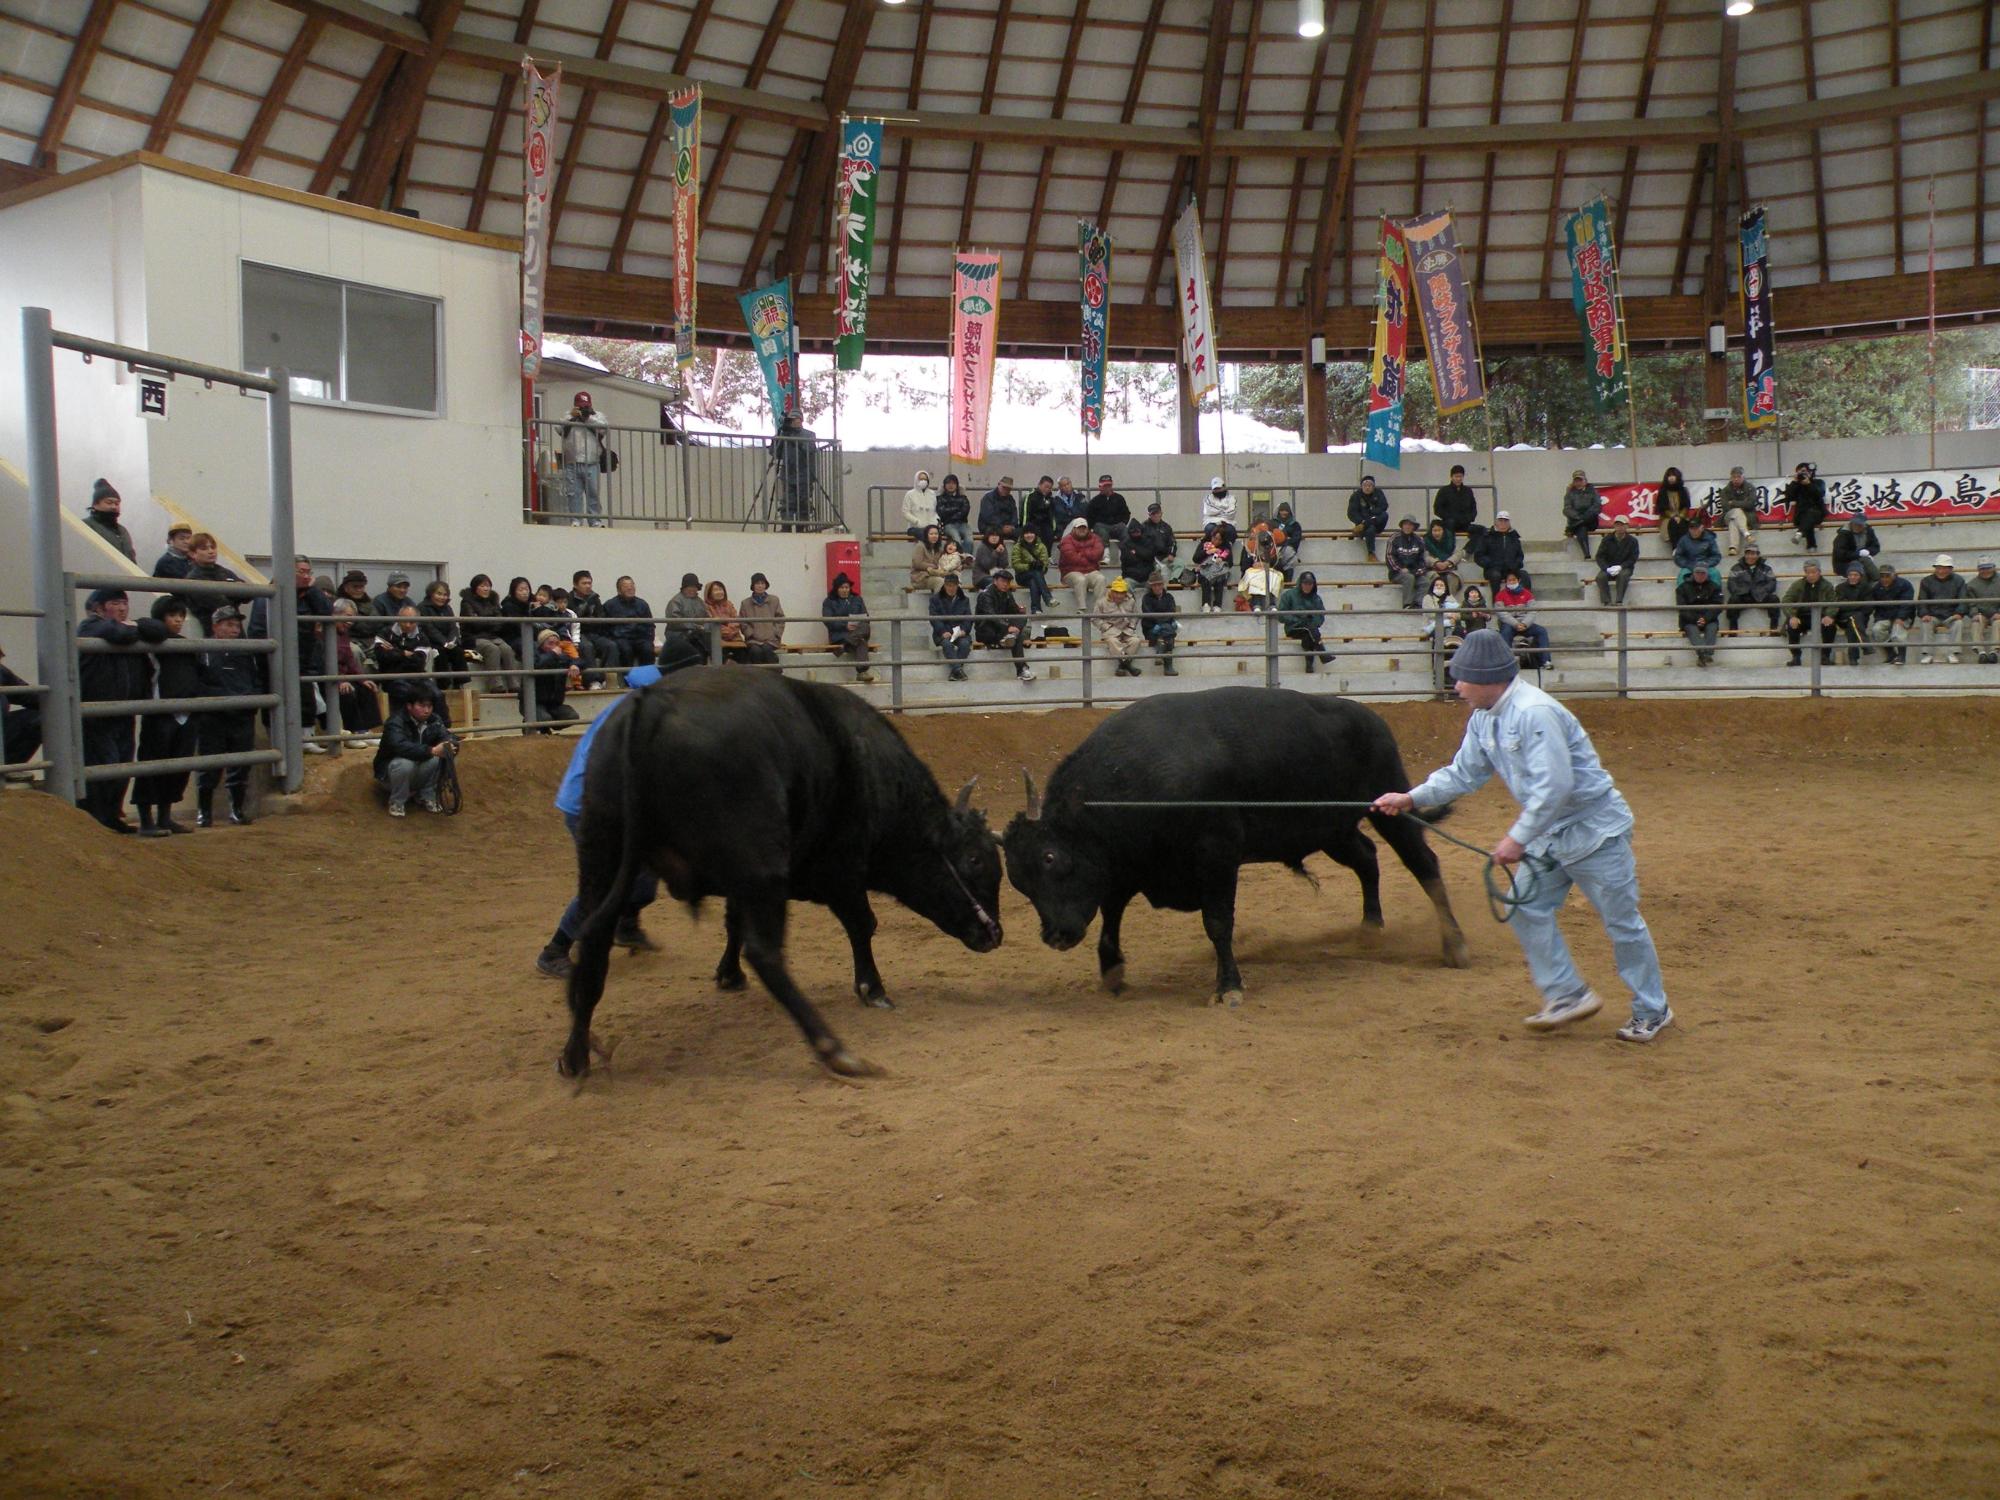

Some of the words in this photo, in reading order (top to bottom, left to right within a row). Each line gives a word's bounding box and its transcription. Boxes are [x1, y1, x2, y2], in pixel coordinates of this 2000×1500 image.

[141, 378, 166, 416] 西
[1828, 473, 2000, 514] 隠岐の島
